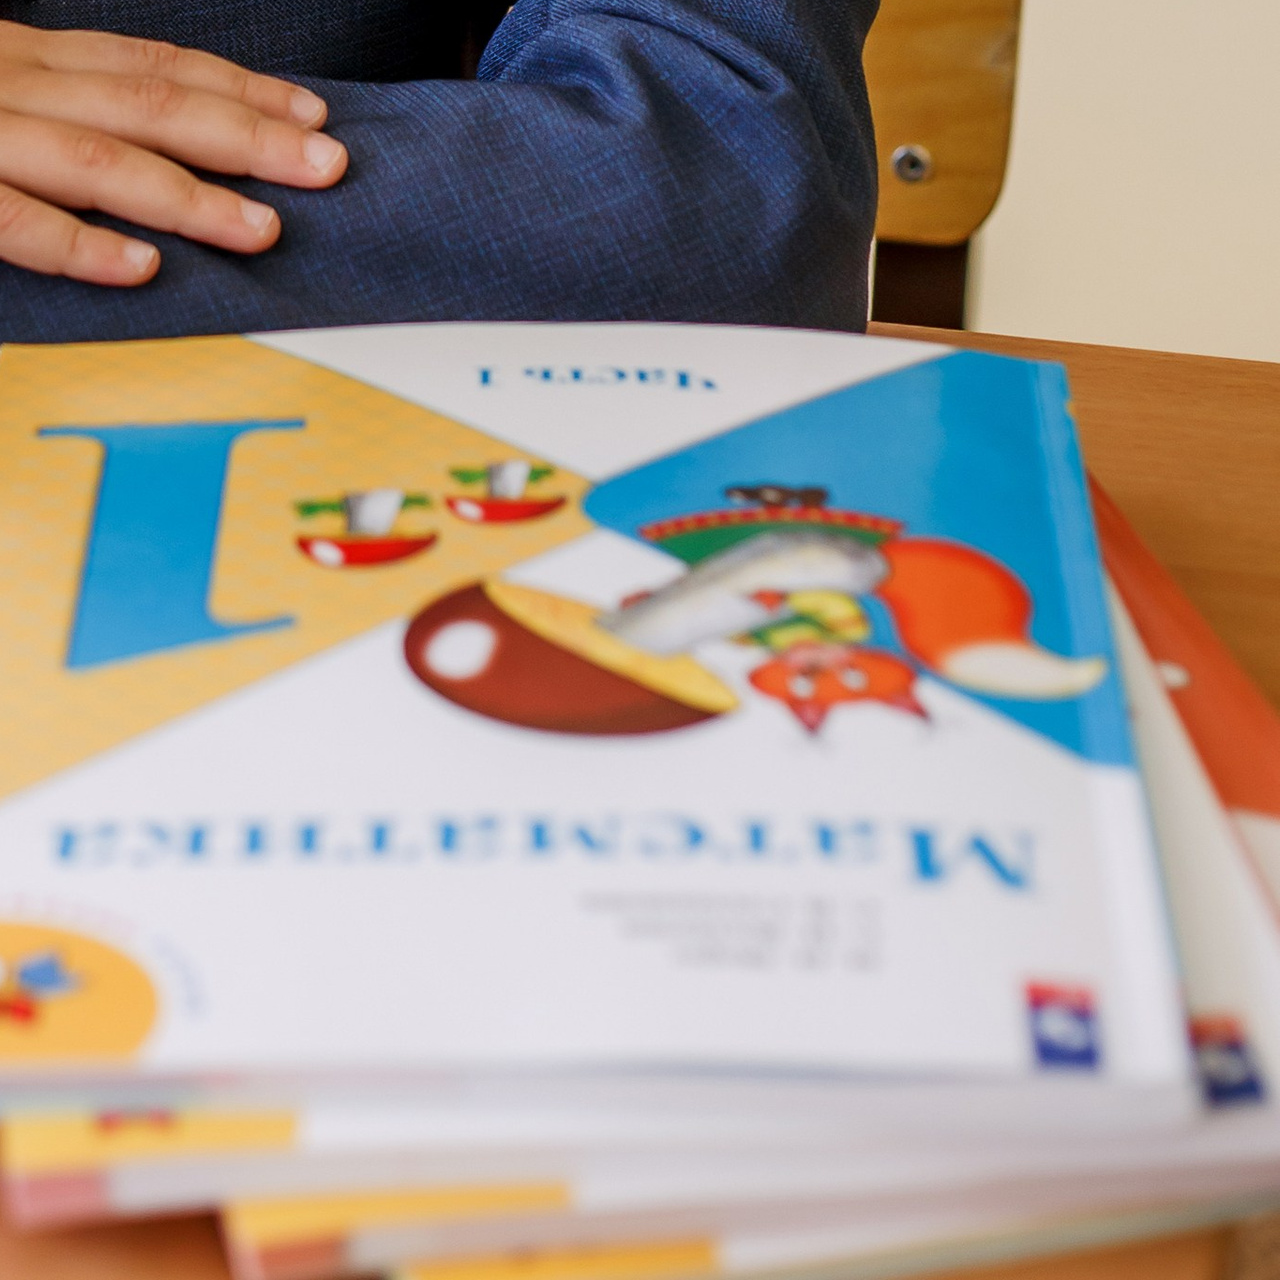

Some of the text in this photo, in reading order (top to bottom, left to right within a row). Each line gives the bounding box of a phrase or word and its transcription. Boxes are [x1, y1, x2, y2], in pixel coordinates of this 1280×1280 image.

[520, 359, 718, 395] Часть
[33, 417, 306, 671] 1
[52, 811, 1040, 893] Математика
